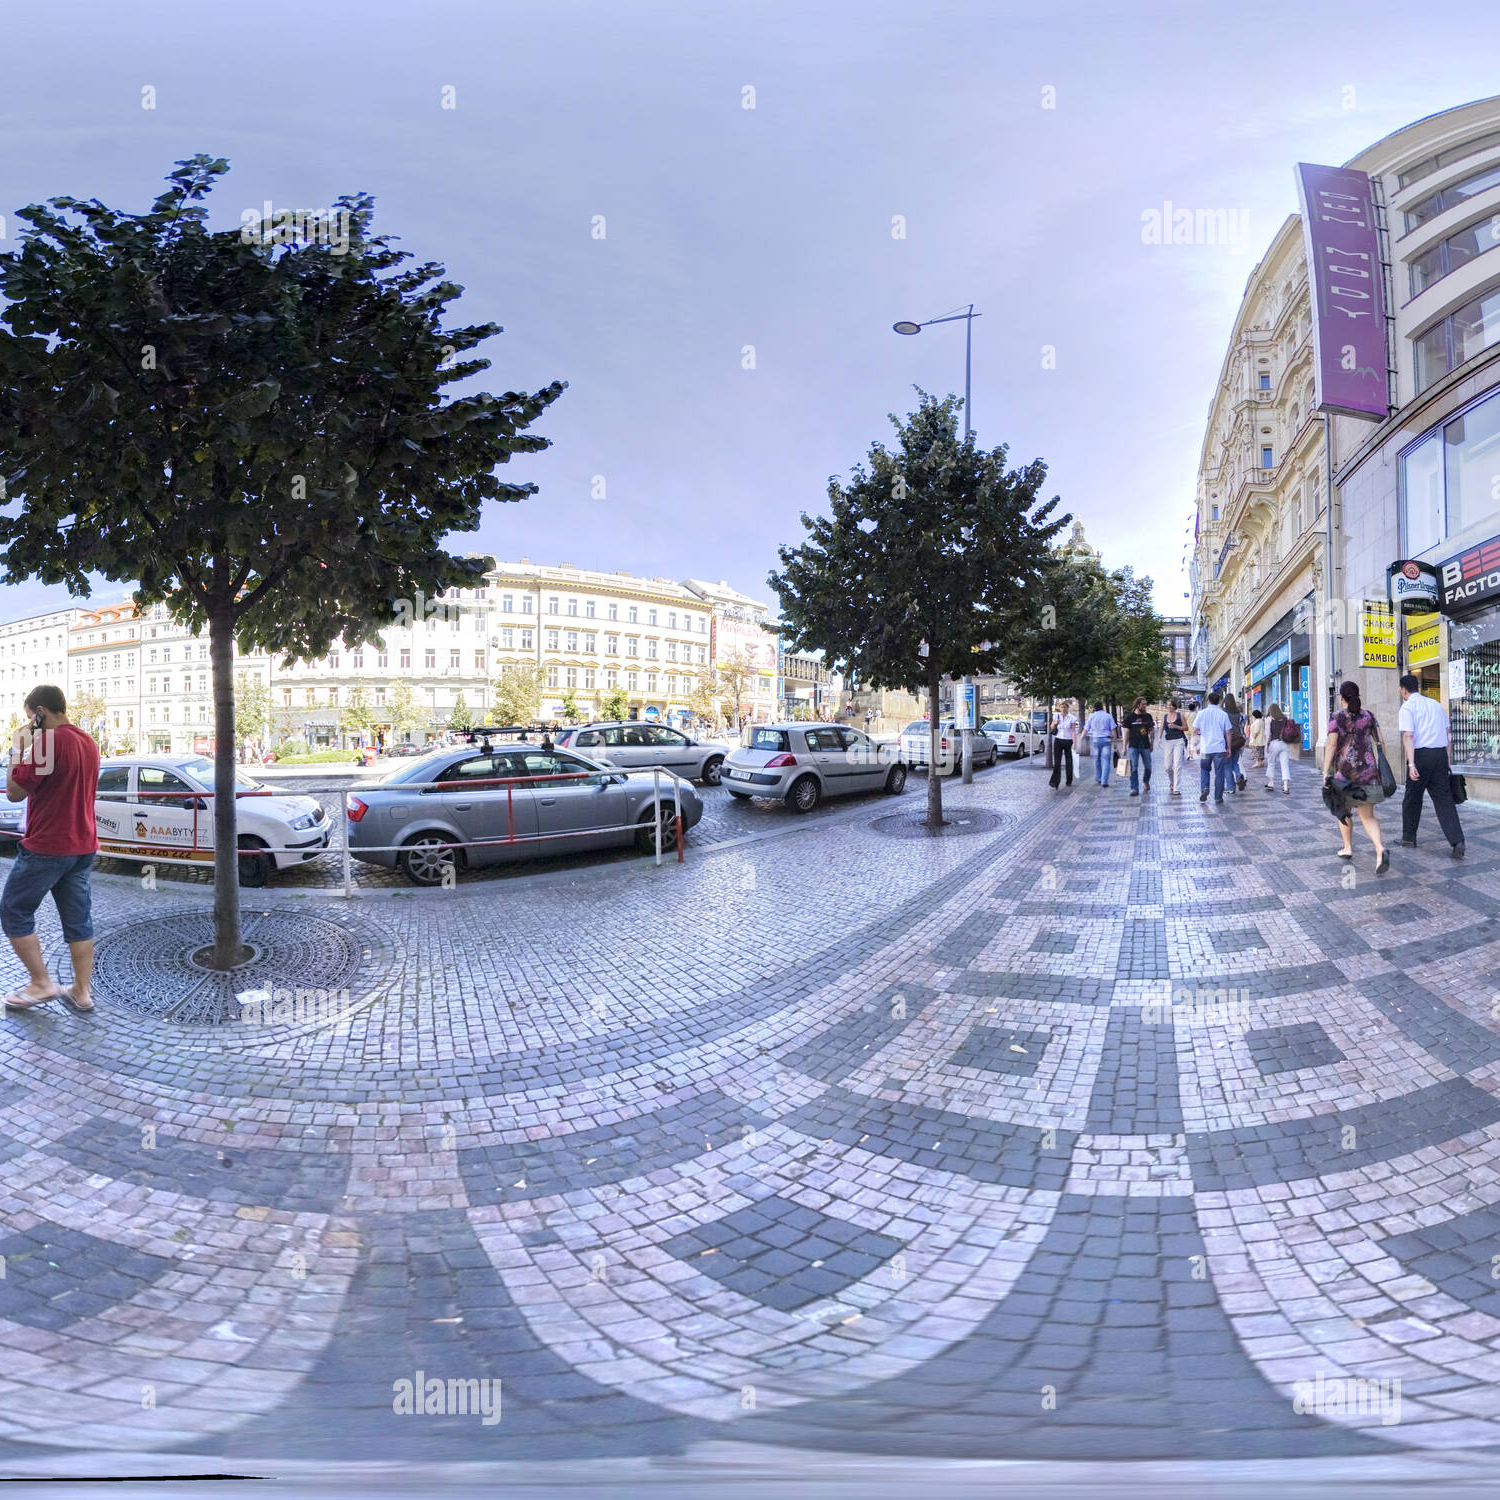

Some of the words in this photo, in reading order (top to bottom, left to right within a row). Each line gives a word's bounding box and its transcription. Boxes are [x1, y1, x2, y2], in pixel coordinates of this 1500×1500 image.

[1445, 571, 1500, 605] FACTO
[1363, 619, 1395, 630] CHANGE
[1363, 636, 1396, 646] WECHSEL
[1409, 636, 1440, 652] CHANGE
[1364, 653, 1396, 663] CAMBIO
